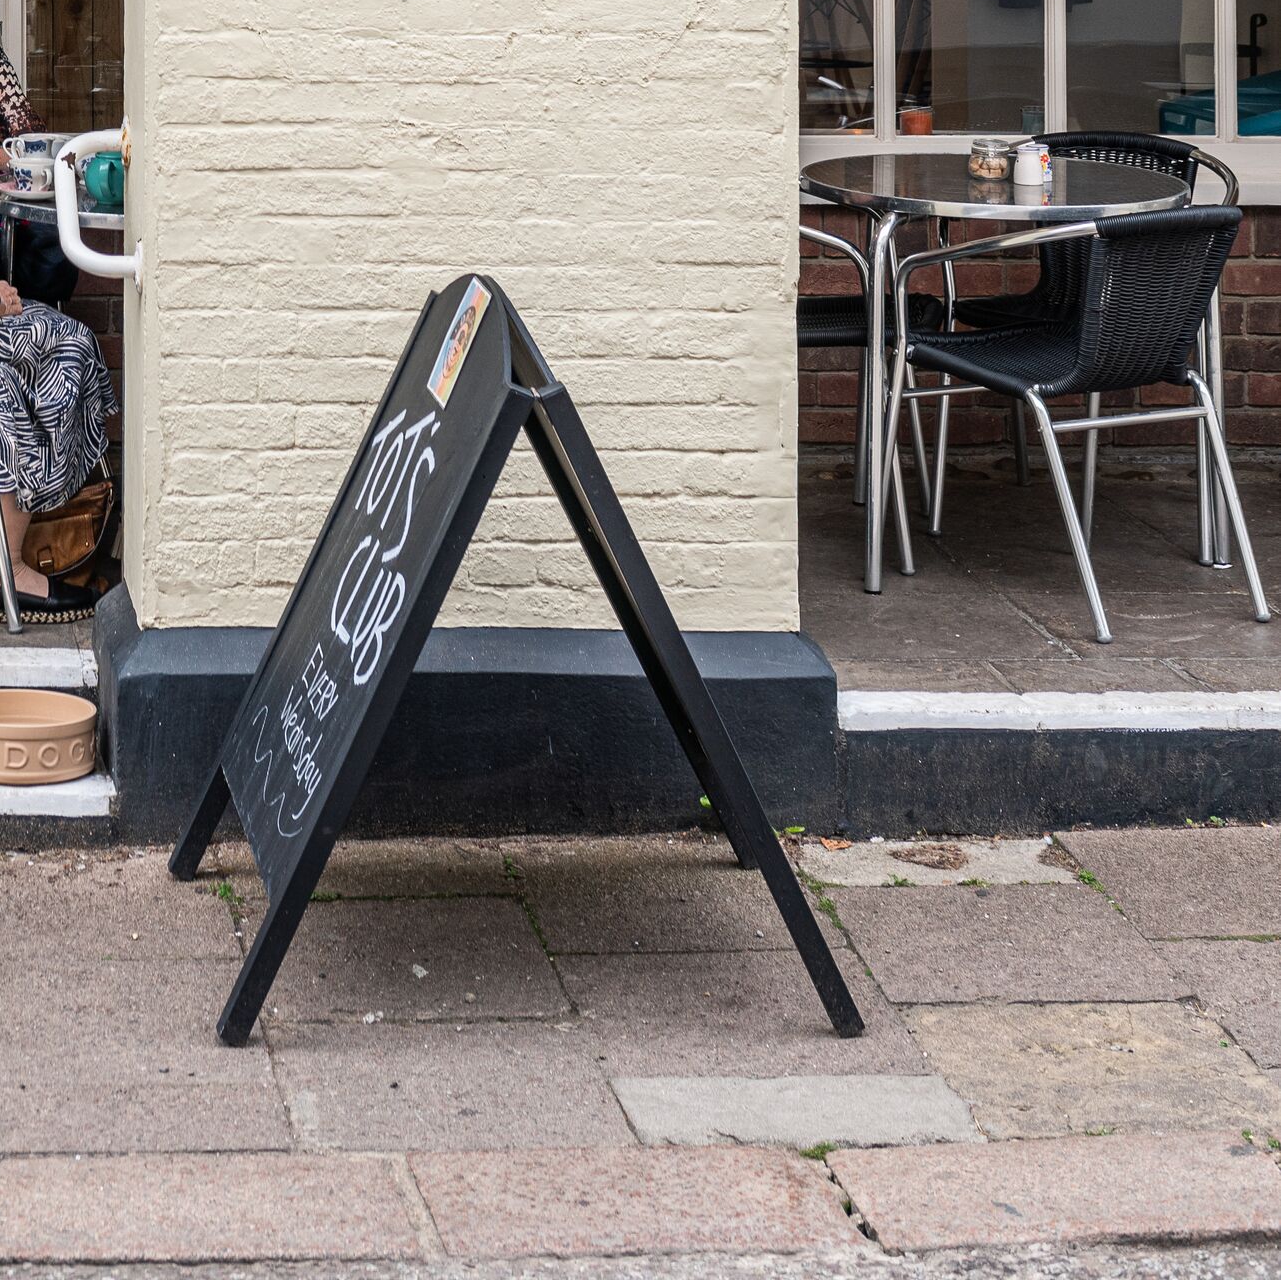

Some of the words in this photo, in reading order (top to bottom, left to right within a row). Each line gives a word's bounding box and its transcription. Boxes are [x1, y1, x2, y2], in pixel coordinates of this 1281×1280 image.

[331, 535, 406, 686] CLUB
[301, 642, 339, 722] EVERY
[4, 740, 85, 769] DOG
